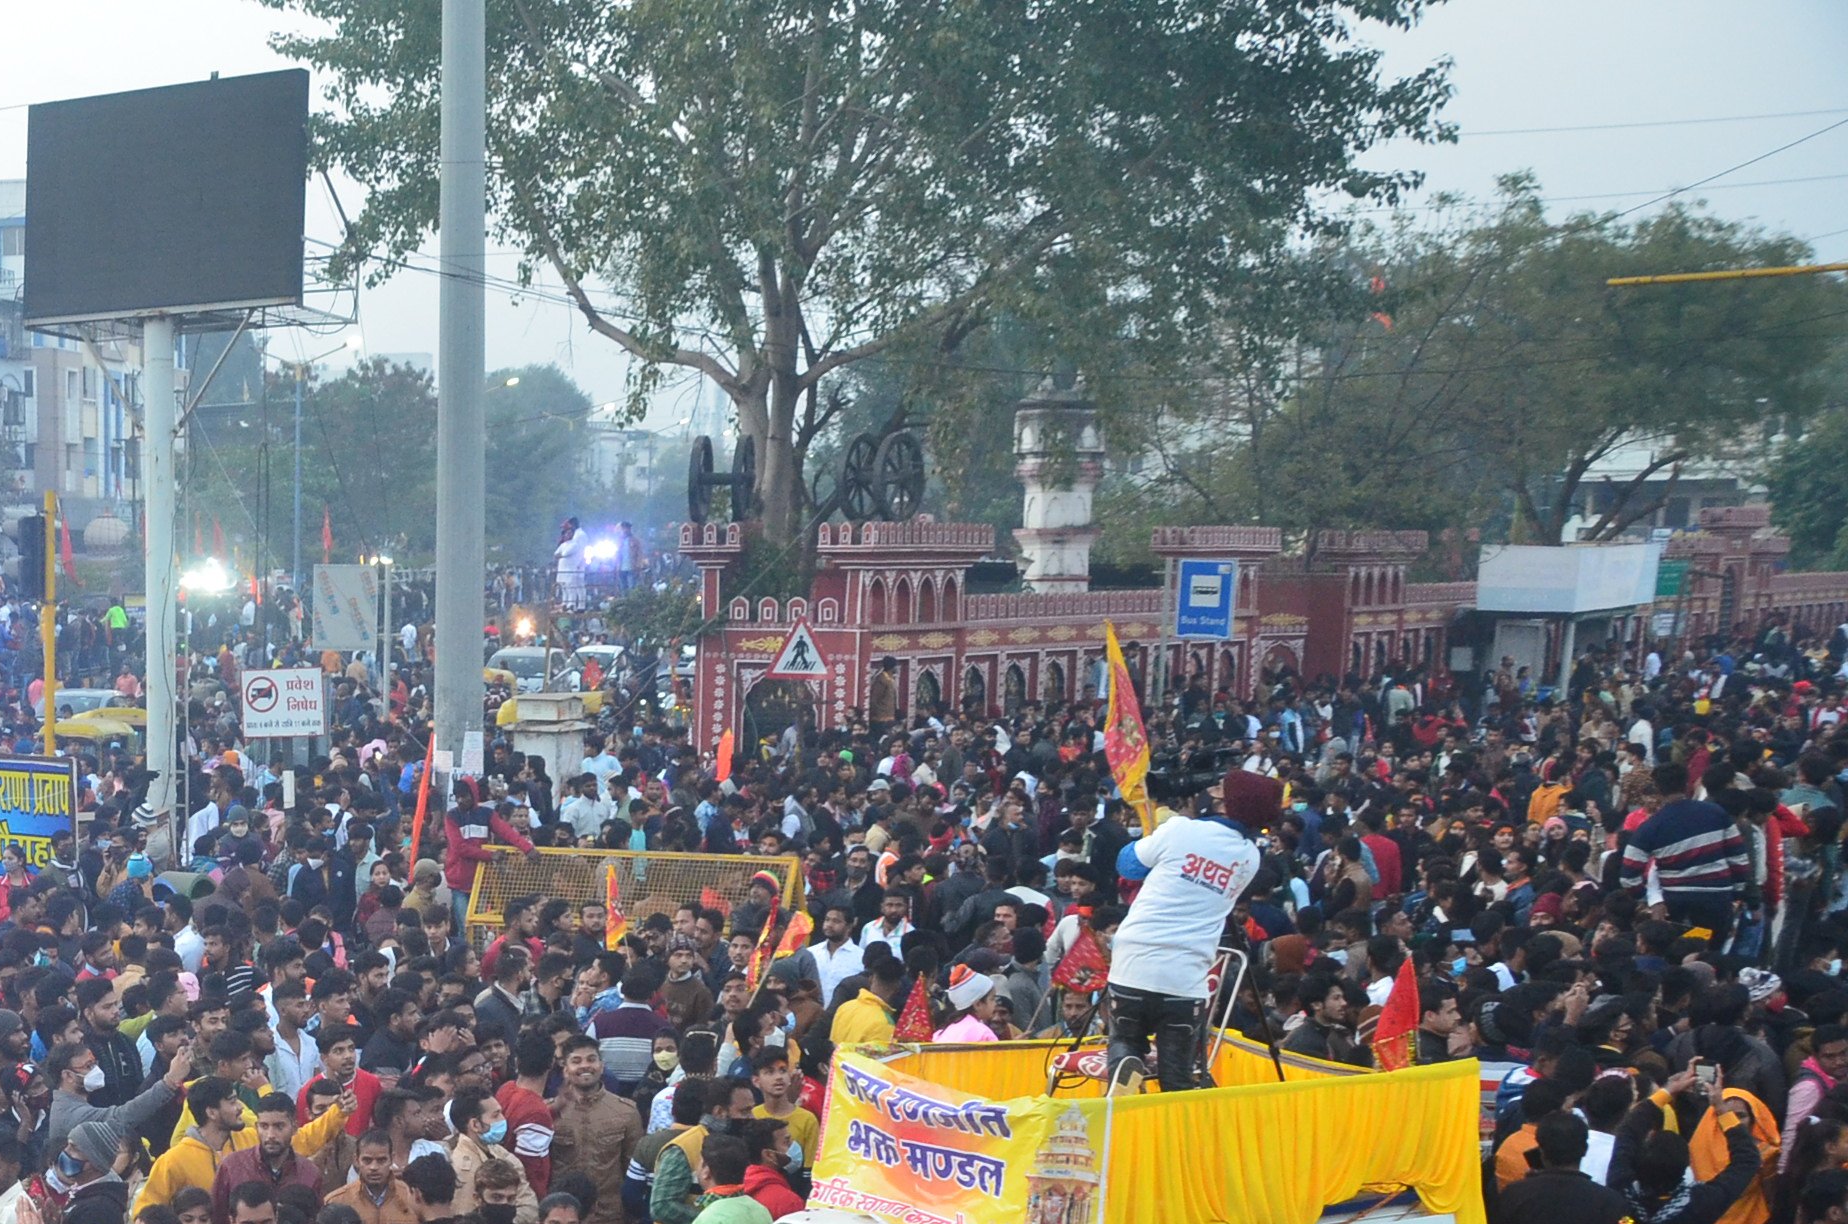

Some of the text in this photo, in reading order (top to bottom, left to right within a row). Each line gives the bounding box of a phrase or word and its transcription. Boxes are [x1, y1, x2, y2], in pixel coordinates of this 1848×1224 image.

[1180, 615, 1226, 626] Bus Stand
[286, 674, 314, 692] प्रवेश
[286, 696, 318, 712] निषेध
[31, 772, 71, 817] प्रताप
[1181, 853, 1238, 889] अथर्व
[840, 1063, 1013, 1139] जय रणजीत
[846, 1119, 1006, 1198] भक्त मण्डल
[808, 1177, 858, 1209] हार्दिक
[856, 1195, 908, 1218] स्वागत
